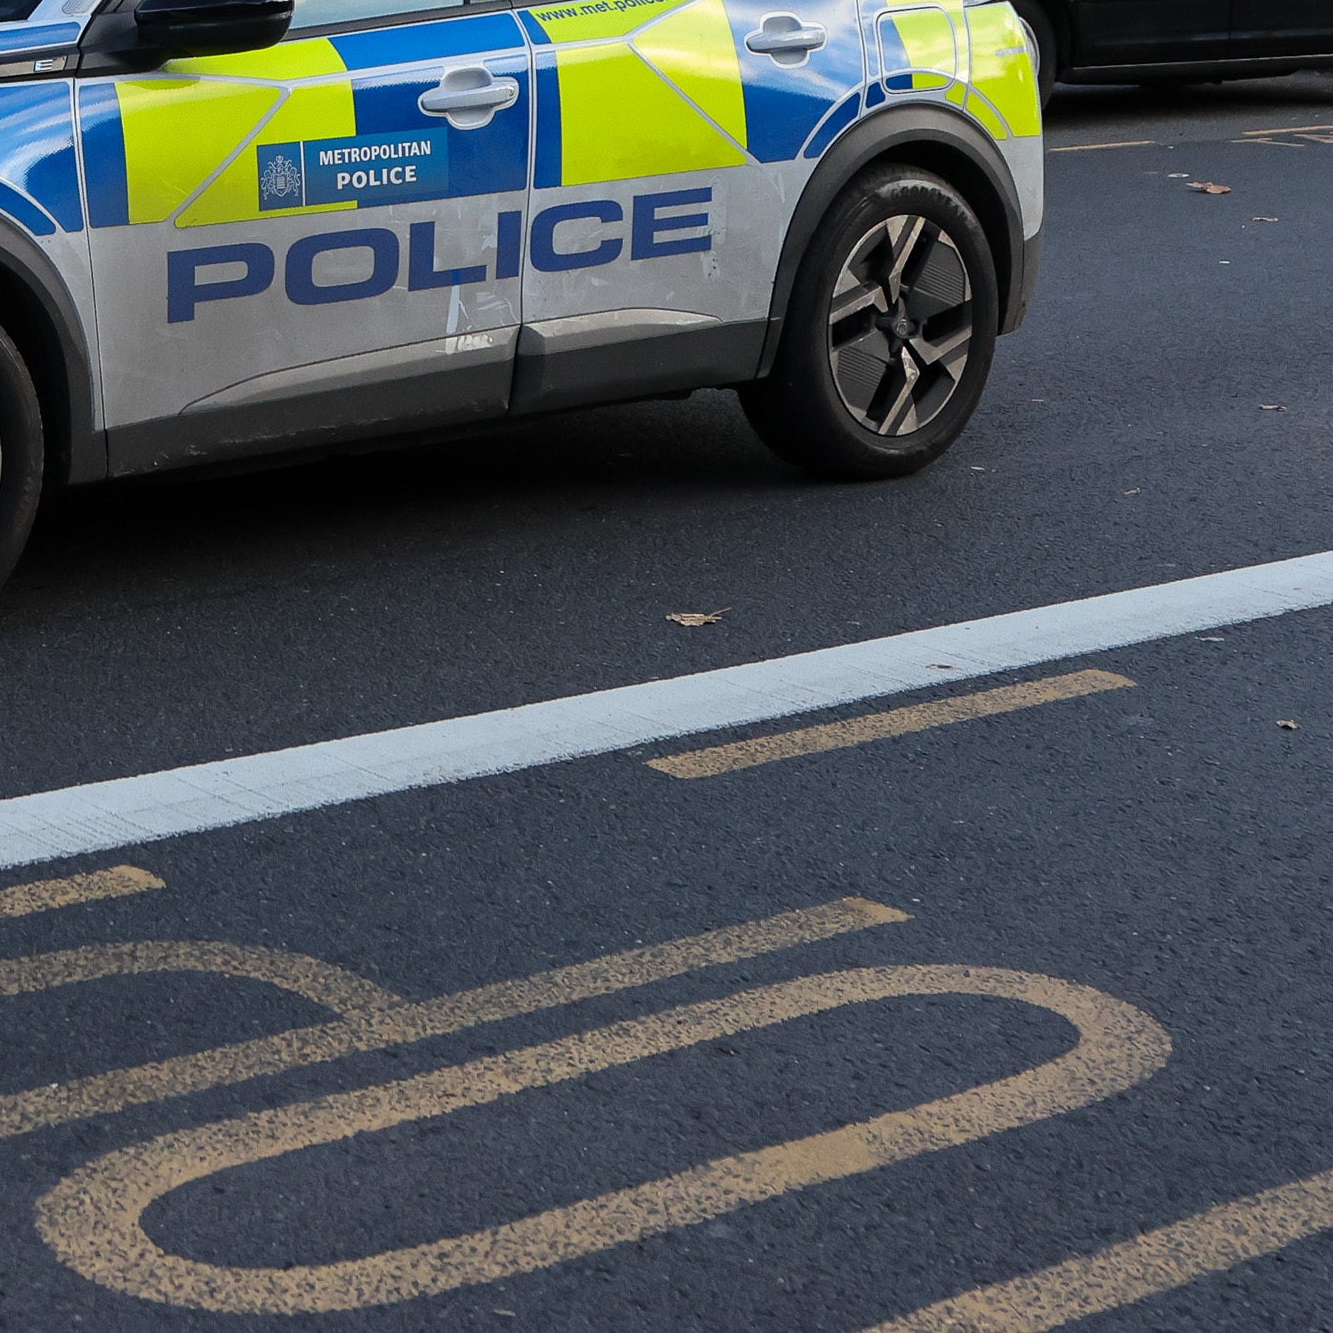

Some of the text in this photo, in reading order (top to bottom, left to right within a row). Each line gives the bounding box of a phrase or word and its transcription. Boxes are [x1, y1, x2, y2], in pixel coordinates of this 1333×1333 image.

[319, 140, 431, 165] METROPOLITAN
[336, 165, 417, 191] POLICE
[167, 188, 713, 324] POLICE
